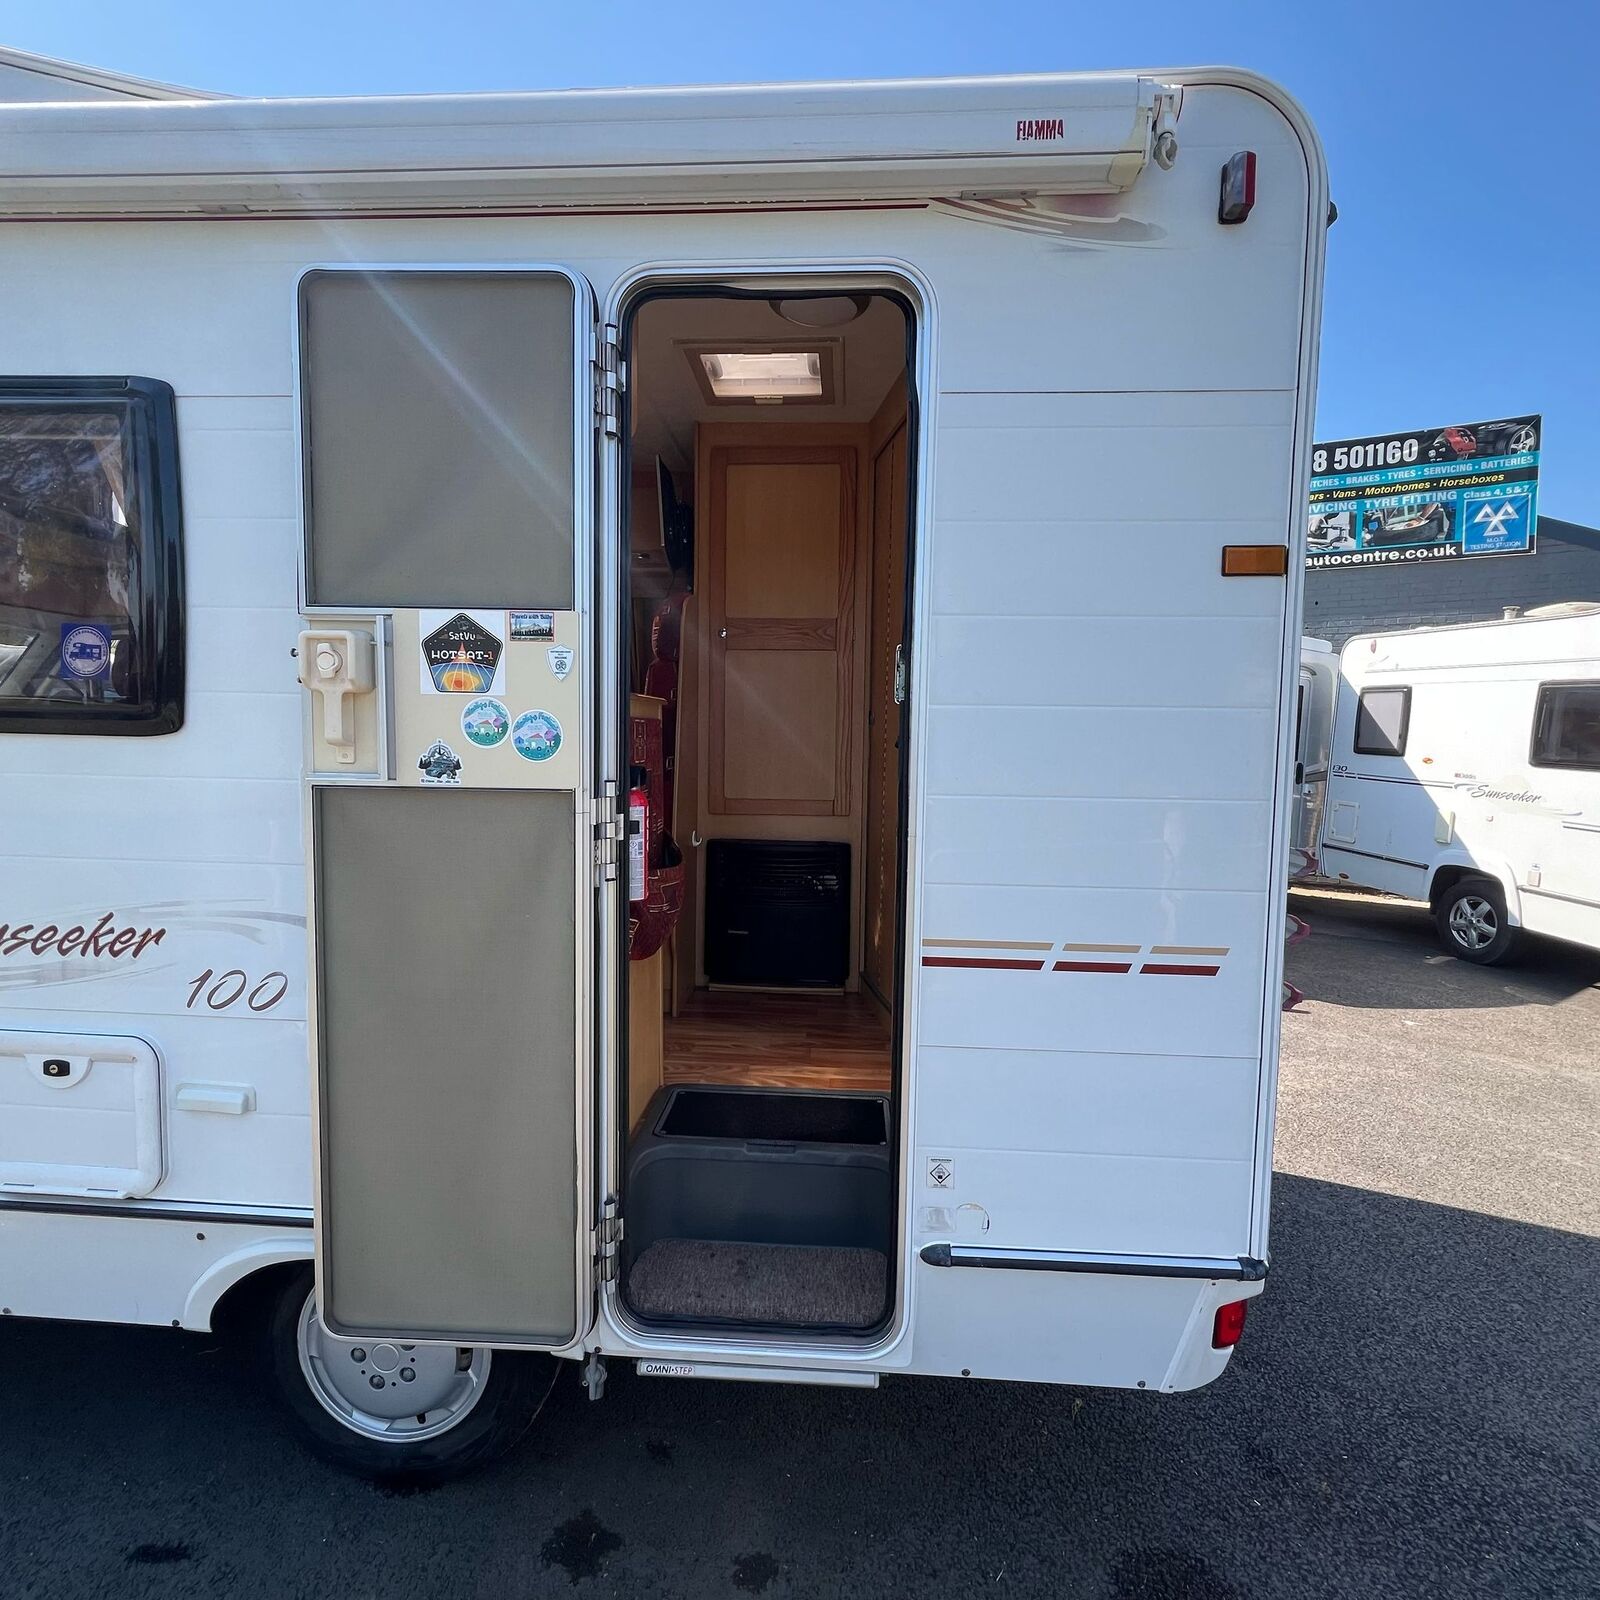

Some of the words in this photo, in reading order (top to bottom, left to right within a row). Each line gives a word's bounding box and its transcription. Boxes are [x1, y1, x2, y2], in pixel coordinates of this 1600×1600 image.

[1017, 119, 1063, 140] FIAMMA
[1312, 449, 1328, 473] 8
[1334, 438, 1419, 470] 501160
[1346, 473, 1380, 485] BRAKES
[1387, 469, 1416, 481] TYRES
[1423, 462, 1473, 476] SERVICING
[1480, 454, 1535, 470] BATTERIES
[1332, 488, 1357, 499] Vans
[1364, 480, 1431, 496] Motorhomes
[1439, 472, 1505, 488] Horseboxes
[1463, 488, 1492, 499] Class
[1364, 496, 1401, 508] TYRE
[1403, 490, 1457, 506] FITTING
[448, 630, 476, 641] SatVu
[431, 649, 494, 660] HOTSAT-1
[1471, 784, 1542, 803] Sunseeker
[186, 968, 289, 1012] 100
